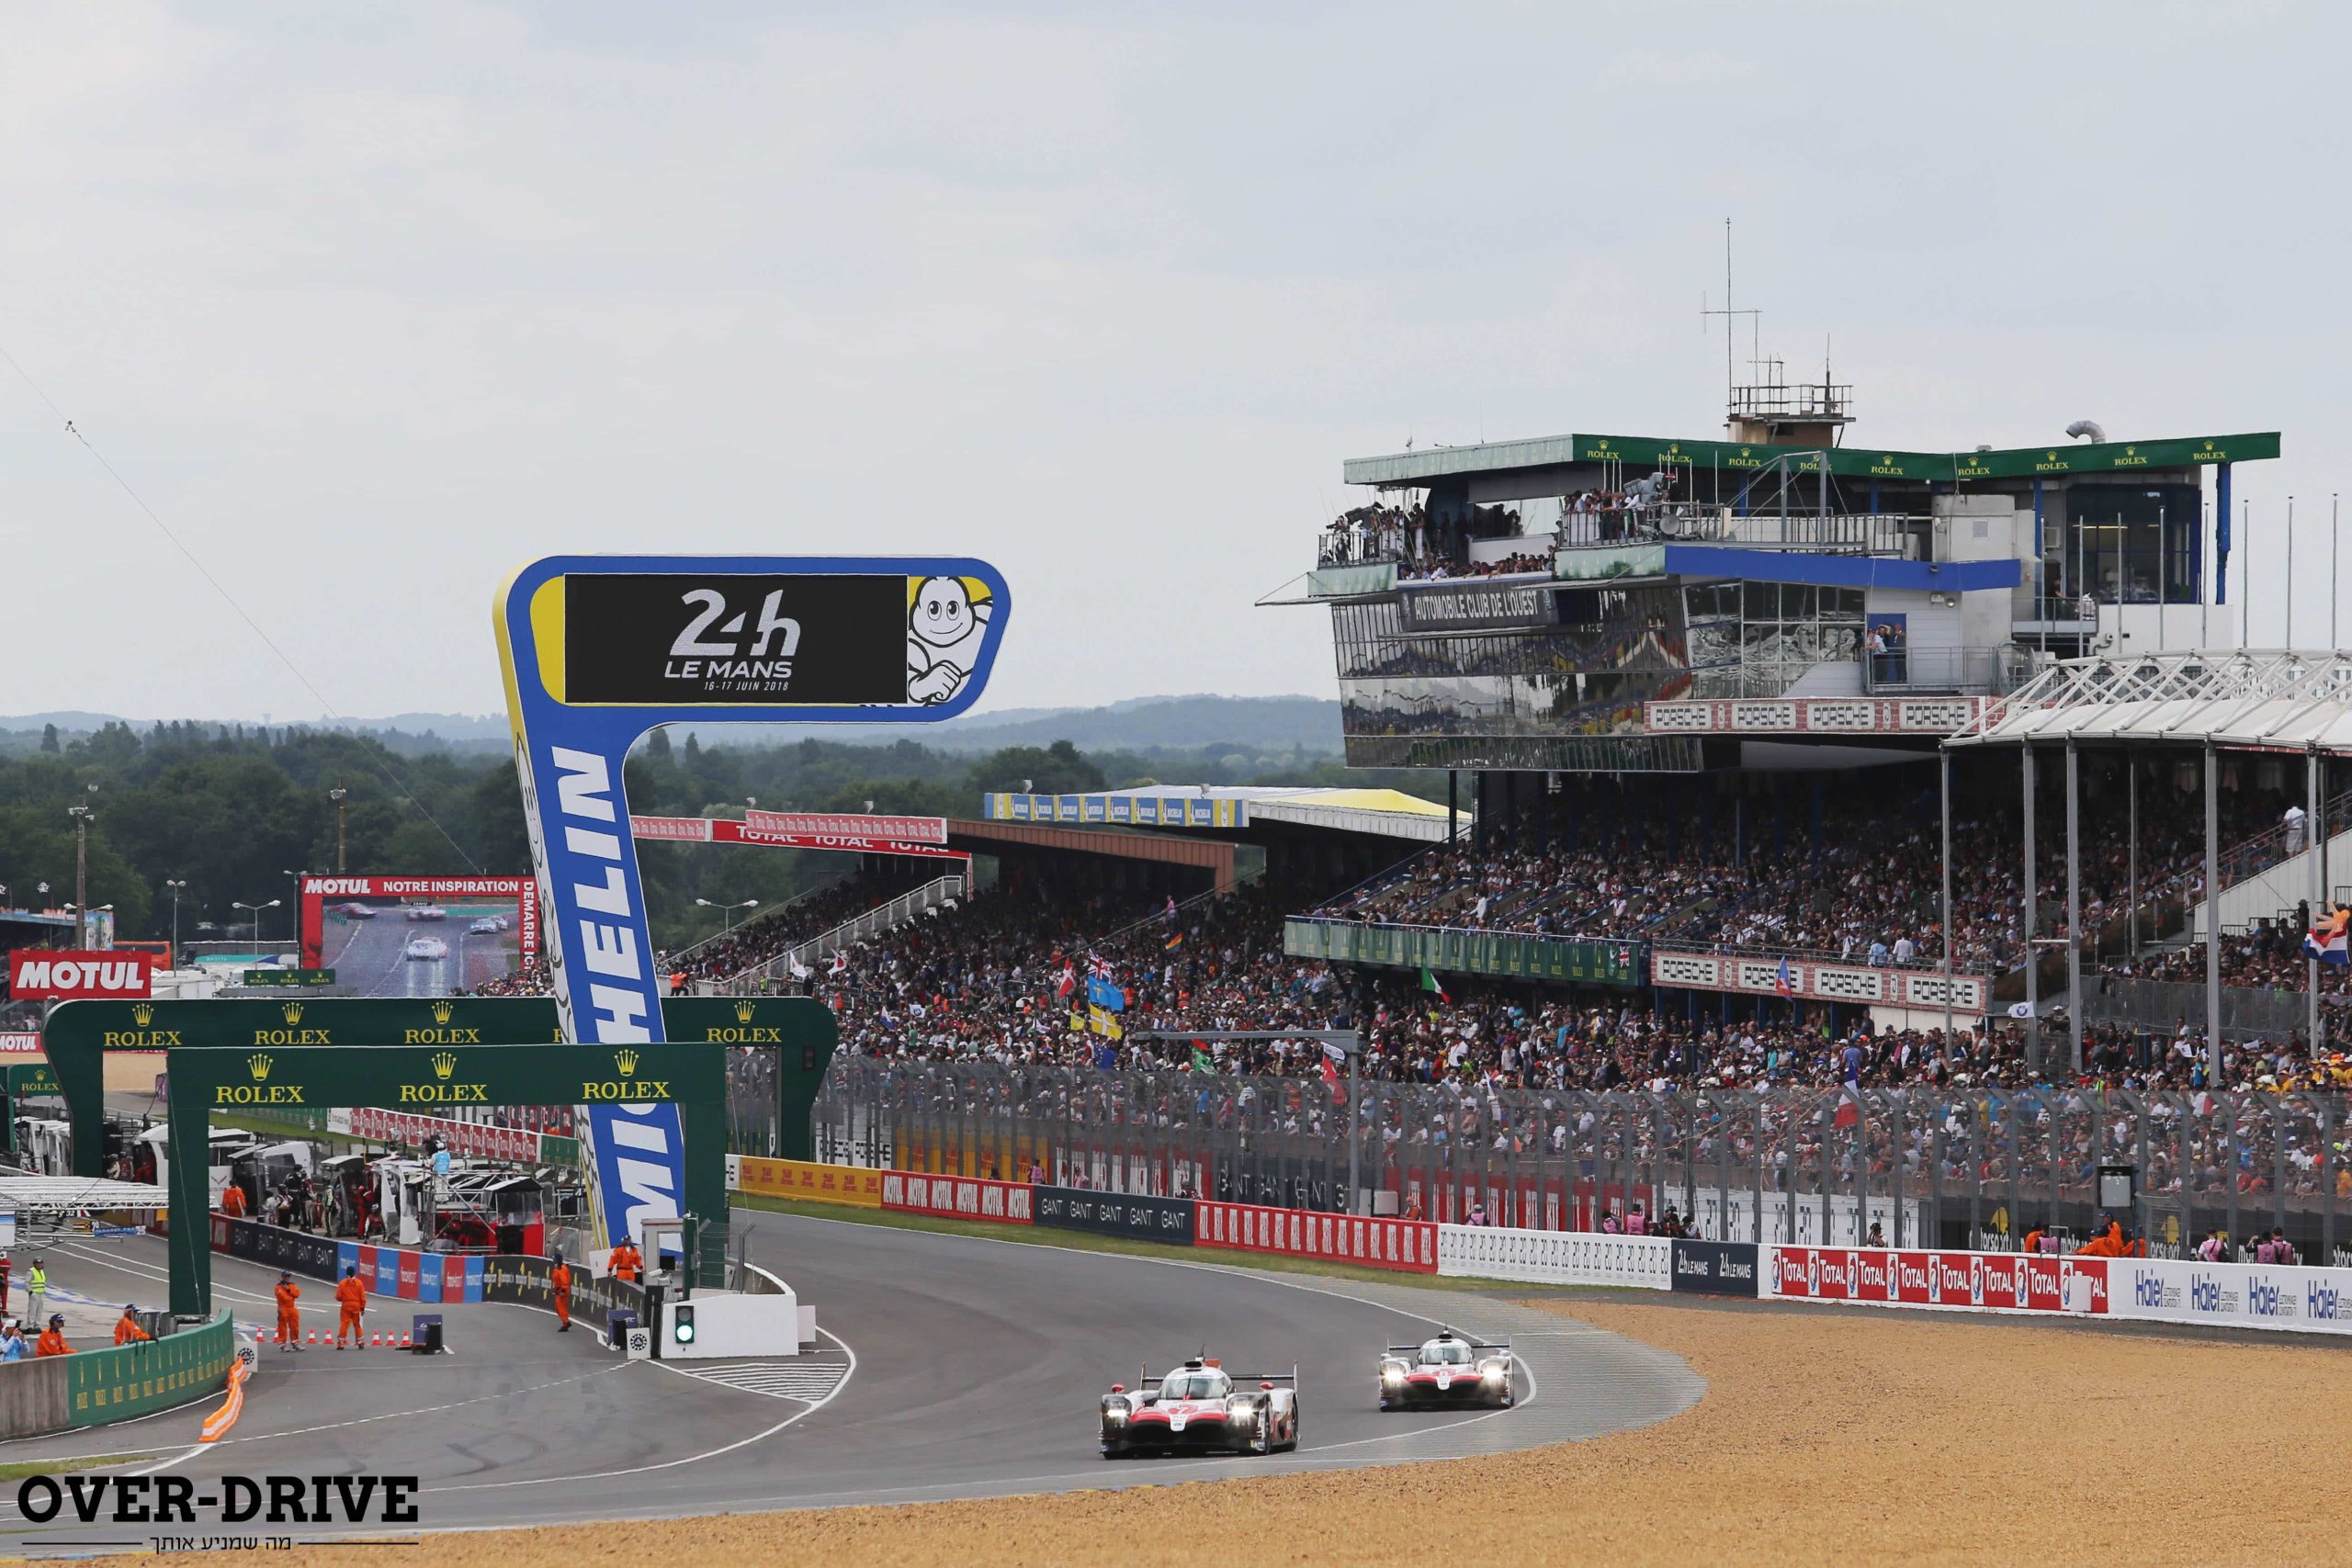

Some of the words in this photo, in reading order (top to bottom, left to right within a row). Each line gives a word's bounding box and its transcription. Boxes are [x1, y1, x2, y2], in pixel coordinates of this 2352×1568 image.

[1588, 450, 1619, 459] ROLEX
[1658, 454, 1690, 463] ROLEX
[1729, 457, 1761, 468] ROLEX
[2115, 457, 2147, 466] ROLEX
[2193, 451, 2226, 460] ROLEX
[1871, 466, 1904, 475] ROLEX
[1958, 467, 1990, 476] ROLEX
[2036, 462, 2069, 470] ROLEX
[1415, 594, 1467, 620] AUTOMOBILE
[1467, 593, 1490, 618] CLUB
[1491, 592, 1503, 617] DE
[1505, 591, 1538, 615] L'OUEST
[664, 661, 701, 678] LE
[707, 661, 792, 678] MANS
[704, 682, 731, 691] 16-17
[736, 682, 760, 691] JUIN
[764, 682, 788, 691] 2018
[1657, 707, 1706, 727] PORSCHE
[1738, 706, 1790, 726] PORSCHE
[1814, 706, 1869, 726] PORSCHE
[1906, 705, 1965, 726] PORSCHE
[305, 879, 371, 894] MOTUL
[383, 881, 429, 892] NOTRE
[431, 881, 518, 892] INSPIRATION
[524, 882, 534, 948] DEMARRE
[17, 961, 144, 990] MOTUL
[1663, 960, 1713, 981] PORSCHE
[1746, 966, 1797, 988] PORSE
[1821, 973, 1876, 995] PORSCHE
[551, 745, 684, 1253] MIHELIN
[104, 1031, 182, 1046] ROLEX
[254, 1030, 331, 1045] ROLEX
[404, 1029, 481, 1044] ROLEX
[707, 1028, 782, 1043] ROLEX
[21, 1083, 59, 1091] ROLEX
[215, 1086, 305, 1104] ROLEX
[400, 1084, 488, 1102] ROLEX
[582, 1081, 671, 1100] ROLEX
[1041, 1198, 1063, 1215] GANT
[1069, 1201, 1092, 1220] GANT
[1100, 1204, 1122, 1223] GANT
[1130, 1207, 1153, 1226] GANT
[1161, 1211, 1185, 1230] GANT
[316, 1247, 333, 1266] GANT
[1687, 1260, 1694, 1274] LE
[1694, 1261, 1708, 1276] MANS
[1729, 1264, 1736, 1278] LE
[1736, 1264, 1751, 1279] MANS
[1782, 1258, 1807, 1283] TOTAL
[1819, 1259, 1847, 1285] TOTAL
[1860, 1260, 1886, 1286] TOTAL
[1900, 1262, 1928, 1289] TOTAL
[1940, 1264, 1970, 1291] TOTAL
[1984, 1266, 2014, 1292] TOTAL
[2029, 1268, 2059, 1295] TOTAL
[2136, 1269, 2165, 1307] Haier
[2192, 1272, 2222, 1312] Haier
[2249, 1275, 2279, 1315] Haier
[2308, 1279, 2338, 1320] Haier
